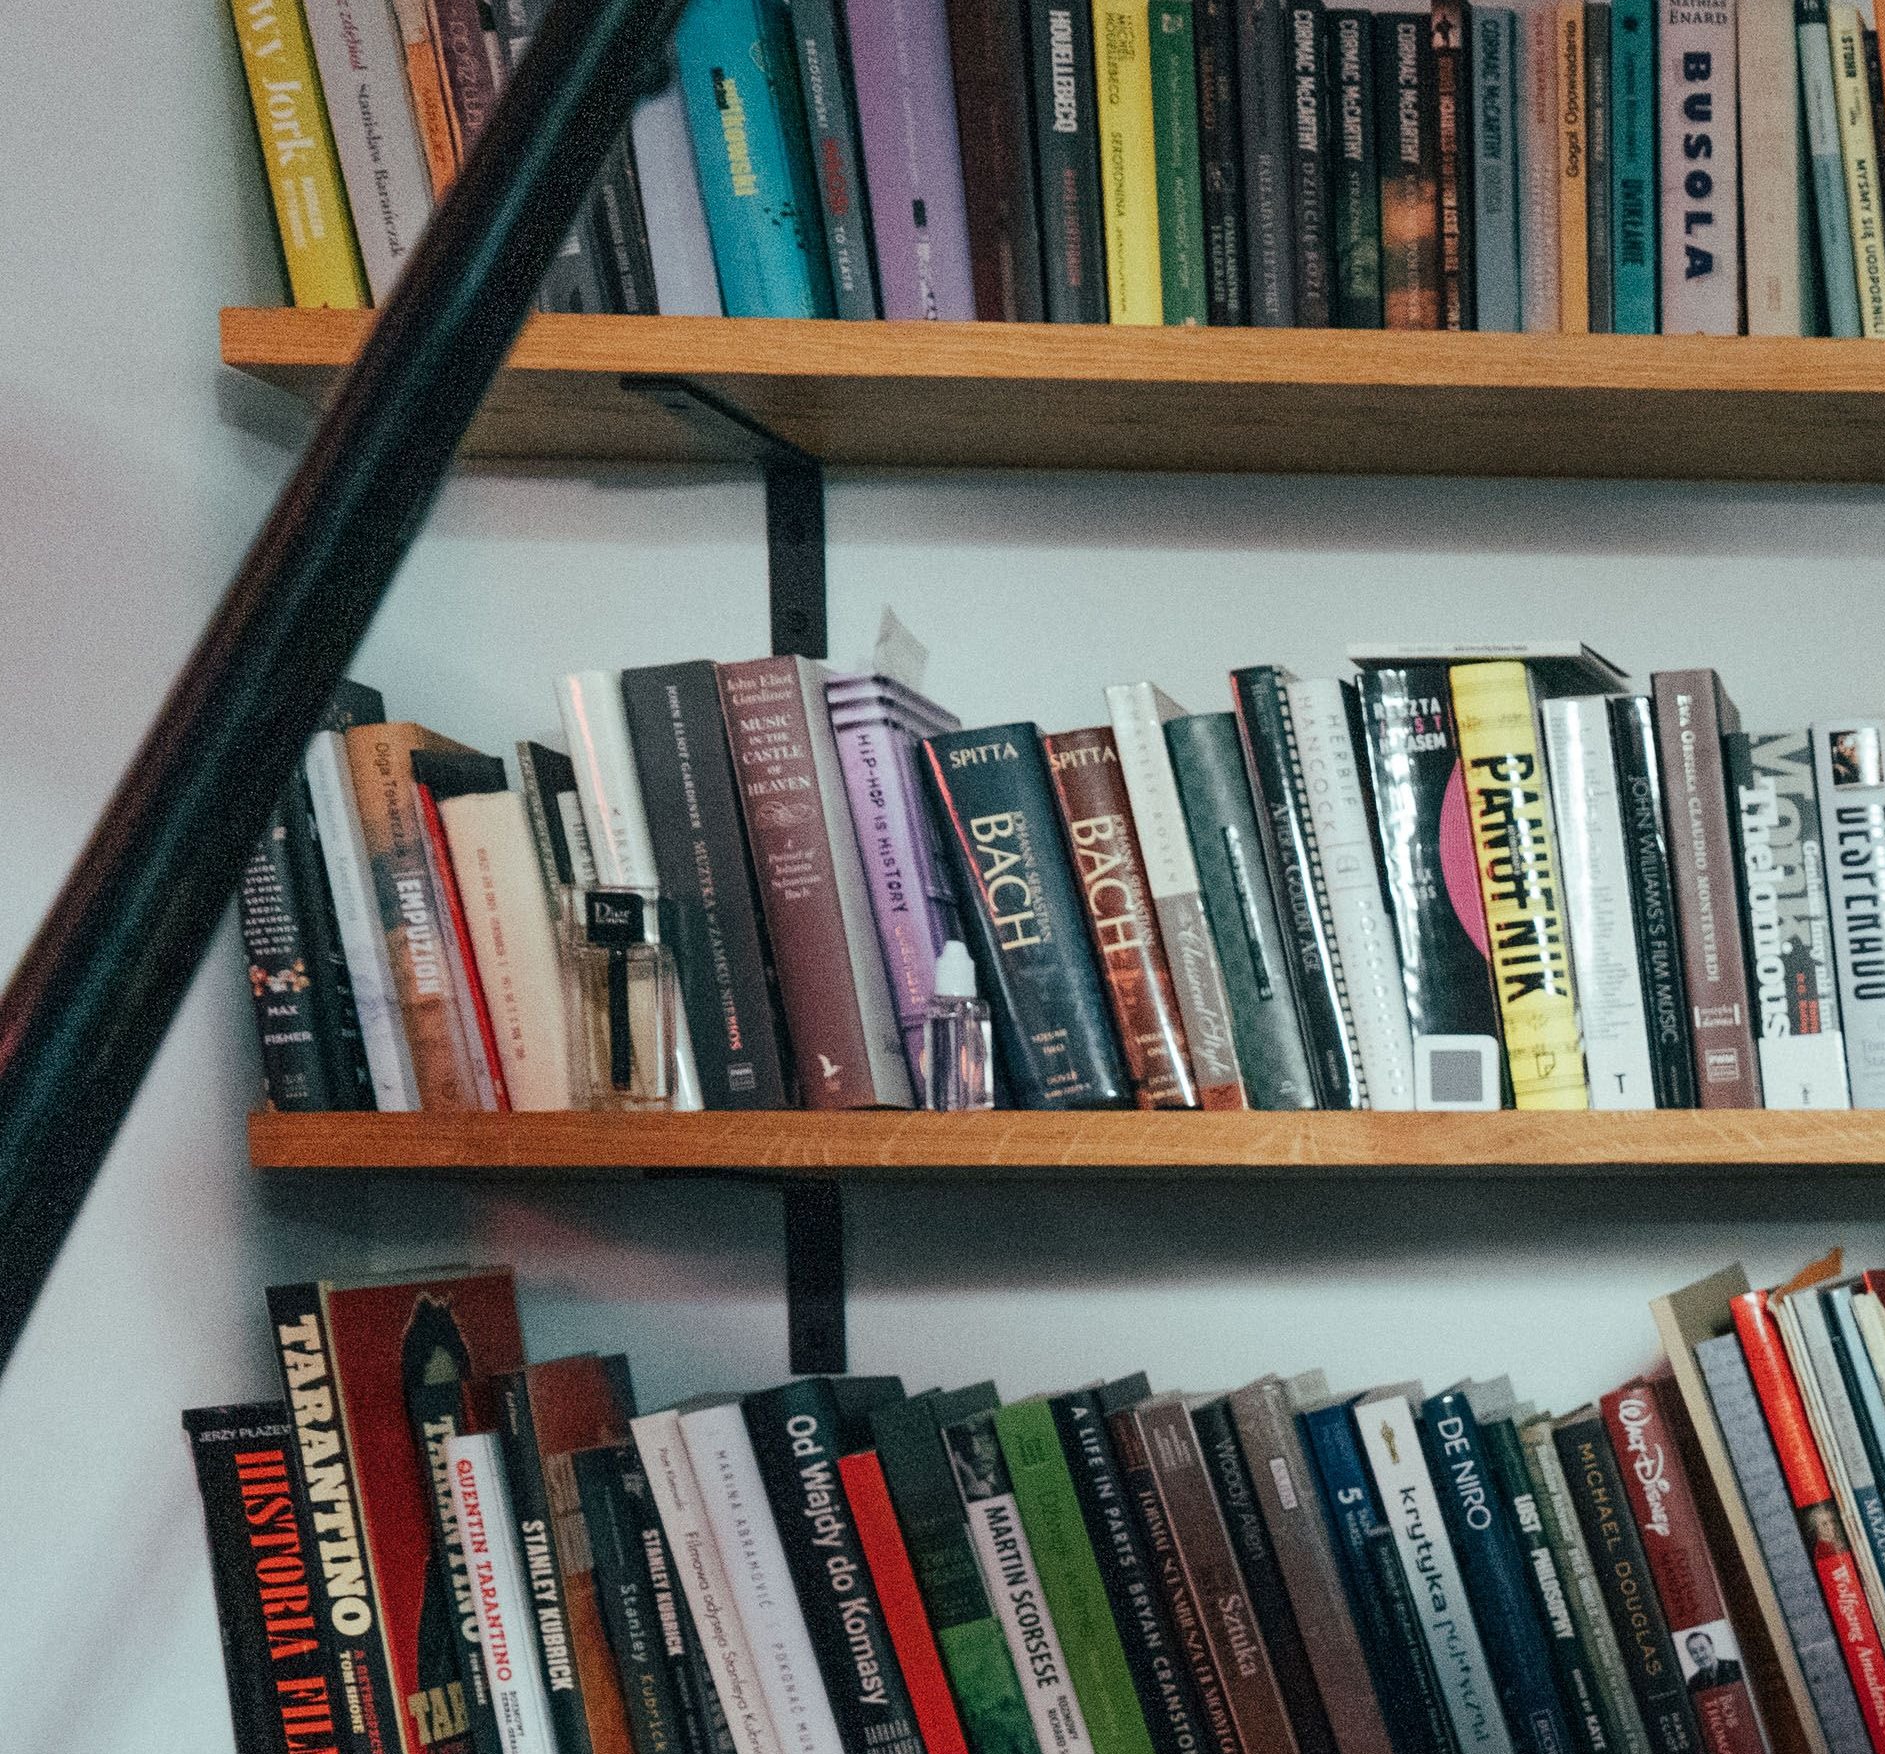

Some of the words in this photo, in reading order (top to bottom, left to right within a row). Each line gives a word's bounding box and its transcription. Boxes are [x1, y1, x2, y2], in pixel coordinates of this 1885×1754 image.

[1293, 10, 1314, 72] CORMAC
[1338, 19, 1360, 82] CORMAC
[1396, 22, 1418, 85] CORMAC
[1481, 20, 1500, 82] CORMAC
[1668, 10, 1728, 26] ENARD
[1049, 10, 1077, 133] HOUELLEBECQ
[265, 75, 318, 167] Jork
[1297, 75, 1318, 152] McCARTHY
[1342, 85, 1363, 161] McCARTHY
[1399, 89, 1420, 163] McCARTHY
[1482, 85, 1501, 159] McCARTHY
[1683, 51, 1713, 281] BUSOLA
[949, 740, 1020, 768] SPITTA
[1049, 747, 1118, 773] SPITTA
[1299, 697, 1334, 833] HANCOCK
[1626, 774, 1653, 827] JOHN
[1686, 796, 1710, 871] CLAUDIO
[1749, 733, 1813, 948] Monk
[968, 811, 1040, 952] BACH
[1069, 815, 1142, 952] BACH
[1470, 753, 1569, 1004] PANUFNIK
[1737, 778, 1791, 1039] Thelonious
[1801, 840, 1824, 916] Geniusz
[1652, 941, 1672, 985] FILM
[1697, 875, 1720, 982] MONTEVERDI
[1808, 920, 1831, 962] inny
[1201, 1018, 1231, 1077] Style
[1655, 988, 1678, 1045] MUSIC
[277, 1313, 373, 1638] TARANTINO
[786, 1414, 818, 1457] Od
[1436, 1416, 1466, 1455] DE
[1451, 1460, 1493, 1531] NIRO
[712, 1448, 740, 1511] MARINA
[798, 1461, 849, 1549] Wajdy
[1336, 1487, 1367, 1506] 5
[1513, 1493, 1545, 1535] LOST
[231, 1450, 319, 1663] HISTORIA
[455, 1458, 490, 1555] QUENTIN
[474, 1559, 513, 1683] TARANTINO
[519, 1519, 555, 1603] STANLEY
[640, 1527, 672, 1593] STANLEY
[825, 1554, 858, 1594] do
[1077, 1427, 1104, 1467] LIFE
[1092, 1475, 1114, 1499] IN
[1103, 1507, 1136, 1567] PARTS
[1126, 1582, 1164, 1649] BRYAN
[1397, 1485, 1449, 1613] krytyka
[1576, 1441, 1622, 1553] MICHAEL
[1613, 1560, 1663, 1678] DOUGLAS
[654, 1594, 685, 1658] KUBRICK
[984, 1505, 1027, 1587] MARTIN
[1010, 1590, 1061, 1689] SCORSESE
[1529, 1547, 1576, 1640] PHILOSOPHY
[1830, 1562, 1861, 1644] Wolfgang
[535, 1607, 574, 1693] KUBRICK
[618, 1583, 648, 1664] Stanley
[638, 1672, 668, 1754] Kubrick
[843, 1597, 891, 1707] Komasy
[1216, 1592, 1259, 1678] Sztuka
